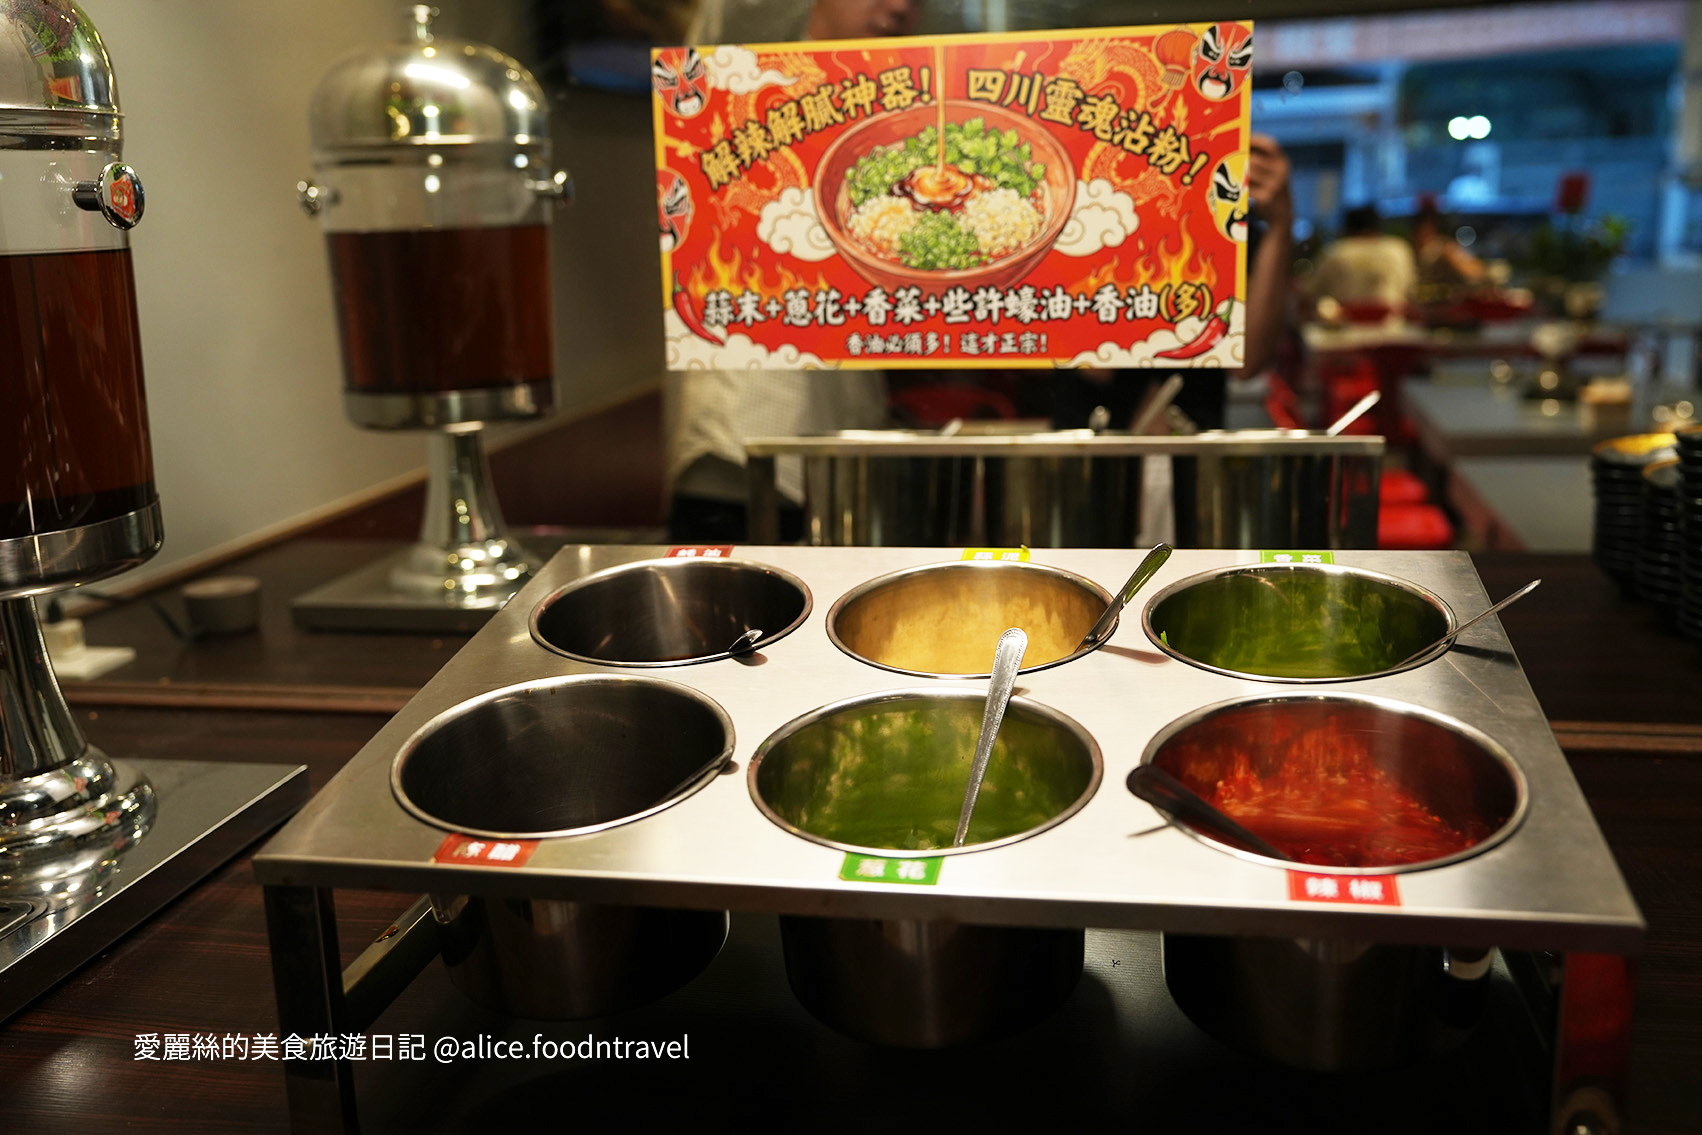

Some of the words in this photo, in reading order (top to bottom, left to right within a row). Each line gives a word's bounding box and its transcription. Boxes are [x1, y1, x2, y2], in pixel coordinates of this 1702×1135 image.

[967, 69, 1209, 185] 四川靈魂沾粉!
